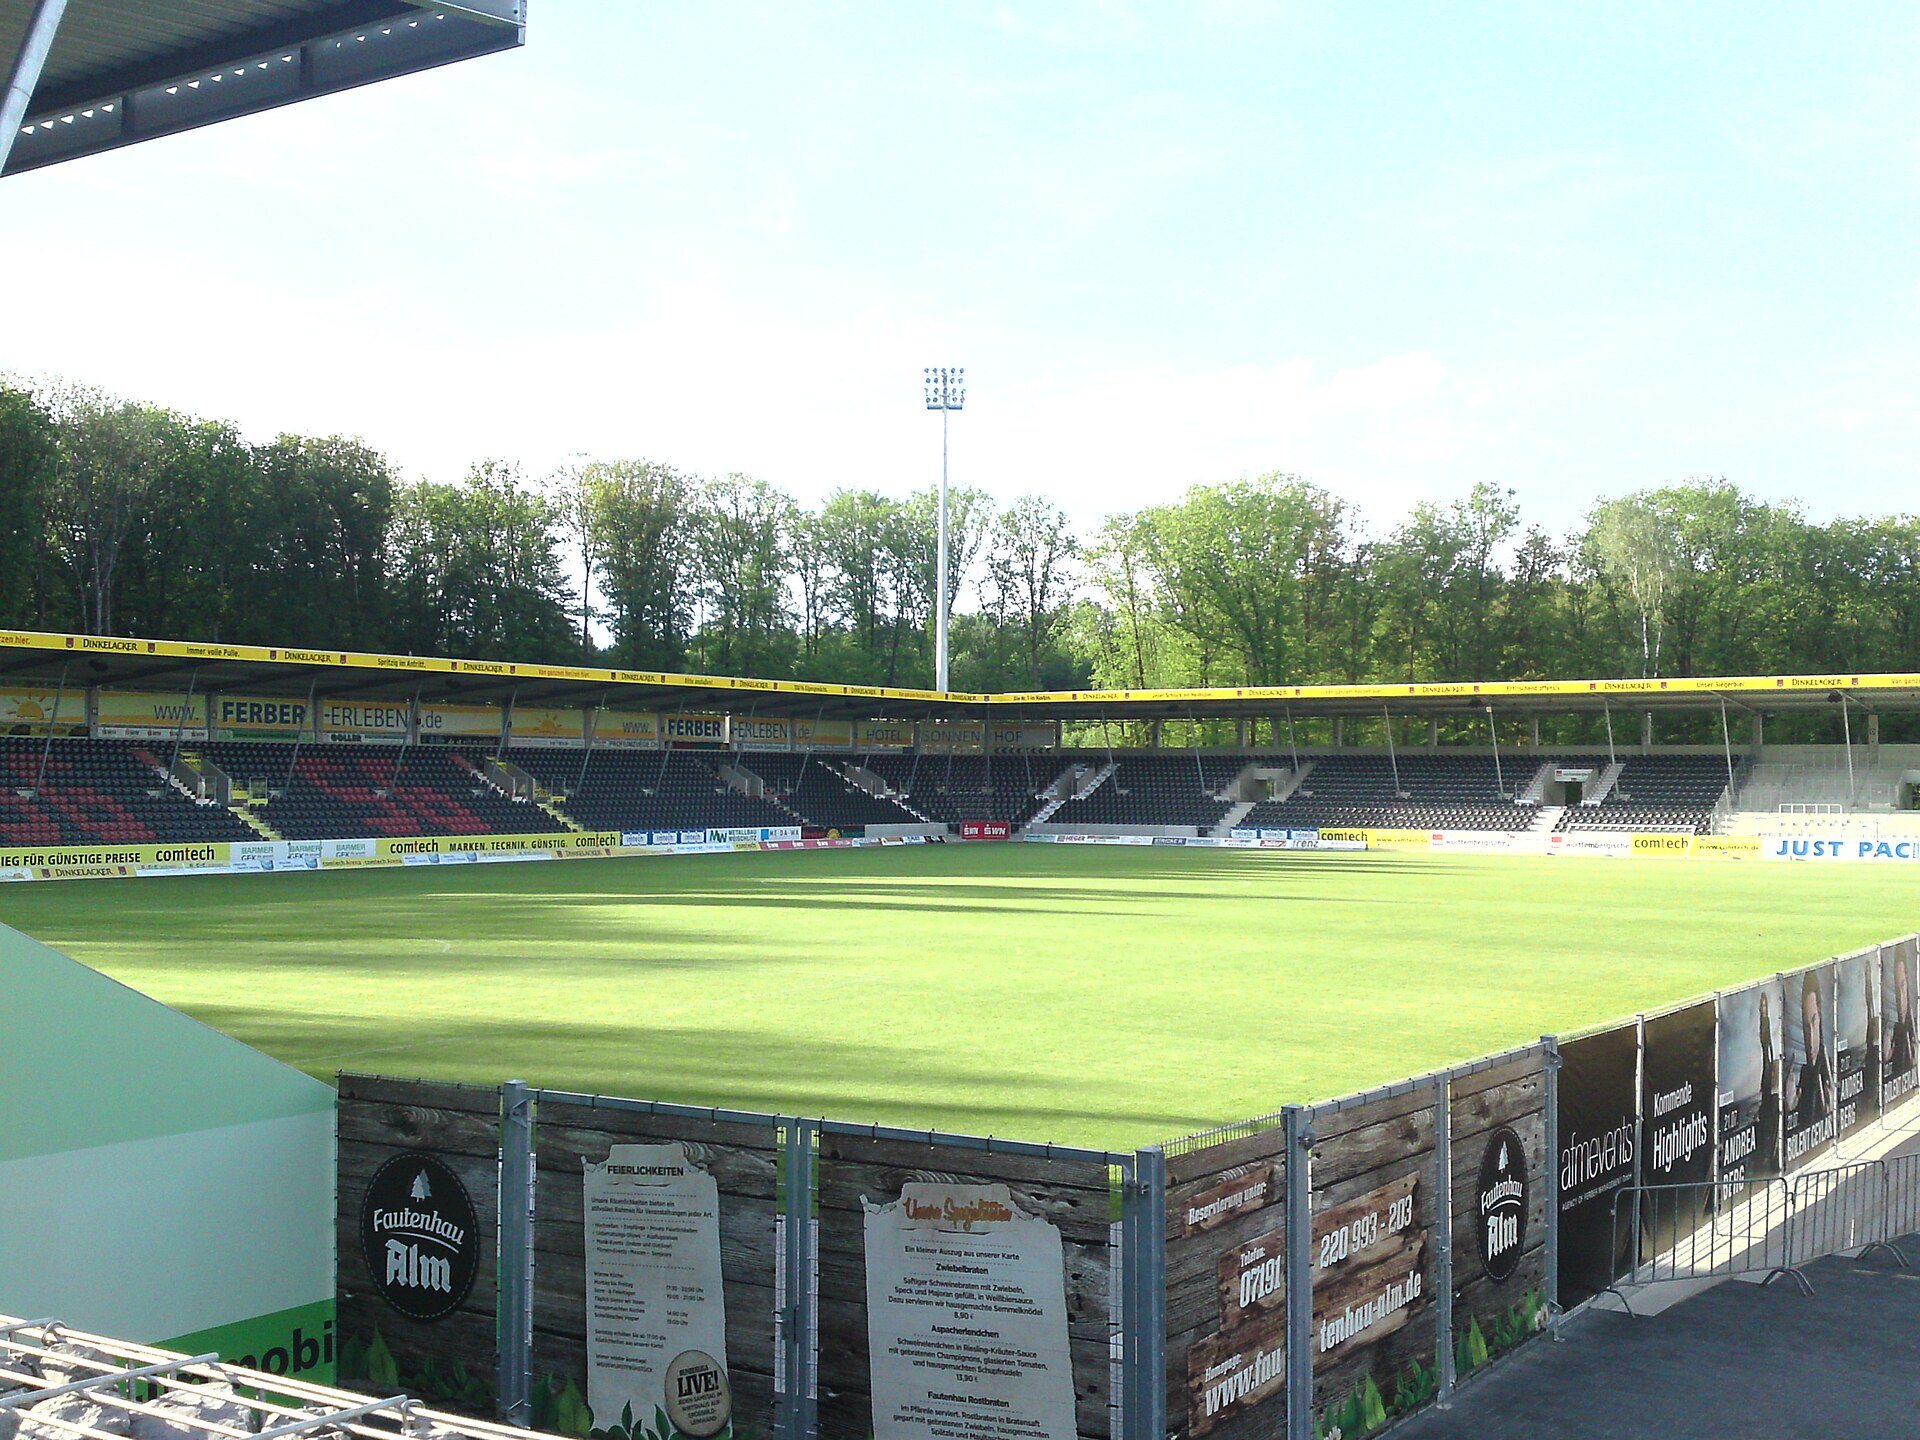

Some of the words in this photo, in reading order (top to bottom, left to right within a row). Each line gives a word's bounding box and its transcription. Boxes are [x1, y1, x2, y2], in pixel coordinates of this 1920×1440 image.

[83, 638, 138, 651] DINKELACKER
[186, 646, 206, 655] Immer
[208, 648, 222, 656] volle
[224, 649, 240, 658] Pulle.
[284, 651, 331, 662] DINKELACKER
[464, 662, 503, 673] DINKELACKER
[222, 702, 306, 724] FERBER
[668, 719, 721, 737] FERBER
[866, 729, 900, 741] HOTEL
[923, 730, 980, 742] SONNEN
[994, 731, 1022, 743] HOF
[449, 843, 488, 851] MARKEN.
[490, 841, 528, 850] TECHNIK.
[532, 838, 568, 849] GÜNSTIG.
[576, 834, 616, 847] comtech
[1321, 831, 1367, 841] comtech
[1634, 837, 1689, 849] comtech
[155, 845, 215, 862] comtech
[390, 838, 438, 854] comtech
[1777, 840, 1844, 856] JUST
[24, 853, 44, 866] FÜR
[48, 852, 102, 865] GÜNSTIGE
[105, 852, 141, 864] PREISE
[55, 868, 114, 877] DINKELACKER
[1654, 1080, 1692, 1118] Kommende
[1653, 1111, 1707, 1172] Highlights
[1723, 1126, 1756, 1166] ANDREA
[1561, 1116, 1633, 1190] afmevents
[607, 1165, 683, 1176] FEIERLICHKEITEN
[1723, 1164, 1745, 1200] BERG
[1188, 1190, 1242, 1226] Reservierung
[1243, 1181, 1267, 1206] unter:
[1481, 1174, 1523, 1216] Fautenhau
[374, 1207, 465, 1245] Fautenhau
[1487, 1212, 1518, 1262] Alm
[916, 1246, 937, 1254] kleiner
[940, 1248, 962, 1257] Auszug
[976, 1251, 1000, 1259] unserer
[1239, 1254, 1282, 1308] 07191
[1320, 1225, 1348, 1269] 220
[1352, 1211, 1378, 1253] 993
[1388, 1194, 1413, 1235] 203
[1240, 1246, 1266, 1268] Telefon:
[385, 1238, 452, 1293] Alm
[936, 1263, 989, 1275] Zwiebelbraten
[895, 1286, 913, 1295] Speck
[915, 1288, 927, 1296] und
[928, 1289, 953, 1299] Majoran
[955, 1291, 976, 1300] gefüllt,
[904, 1277, 927, 1286] Saftiger
[929, 1279, 979, 1290] Schweinebraten
[981, 1283, 991, 1291] mit
[992, 1284, 1025, 1294] Zwiebeln,
[888, 1296, 904, 1304] Dazu
[905, 1297, 934, 1306] servieren
[946, 1300, 992, 1311] hausgemachte
[994, 1305, 1043, 1316] Semmelknödel
[931, 1325, 1000, 1338] Aspacherlendchen
[1204, 1348, 1282, 1416] www.fau
[1320, 1270, 1422, 1352] tenhau-alm.de
[901, 1348, 935, 1359] gebratenen
[937, 1351, 982, 1364] Champignons,
[984, 1356, 1016, 1367] glasierten
[1017, 1359, 1048, 1371] Tomaten,
[1204, 1352, 1242, 1383] Homepage:
[926, 1360, 976, 1372] hausgemachten
[978, 1366, 1022, 1377] Schupfnudeln
[677, 1370, 719, 1397] LIVE!
[956, 1374, 973, 1382] 13,90
[928, 1391, 967, 1403] Fautenhau
[968, 1396, 1009, 1408] Rostbraten
[893, 1414, 914, 1423] gegart
[915, 1416, 926, 1424] mit
[927, 1417, 963, 1428] gebratenen
[964, 1422, 995, 1433] Zwiebeln,
[997, 1426, 1050, 1438] hausgemachten
[961, 1411, 997, 1422] Rostbraten
[1006, 1417, 1040, 1427] Bratensaft
[956, 1430, 968, 1438] und
